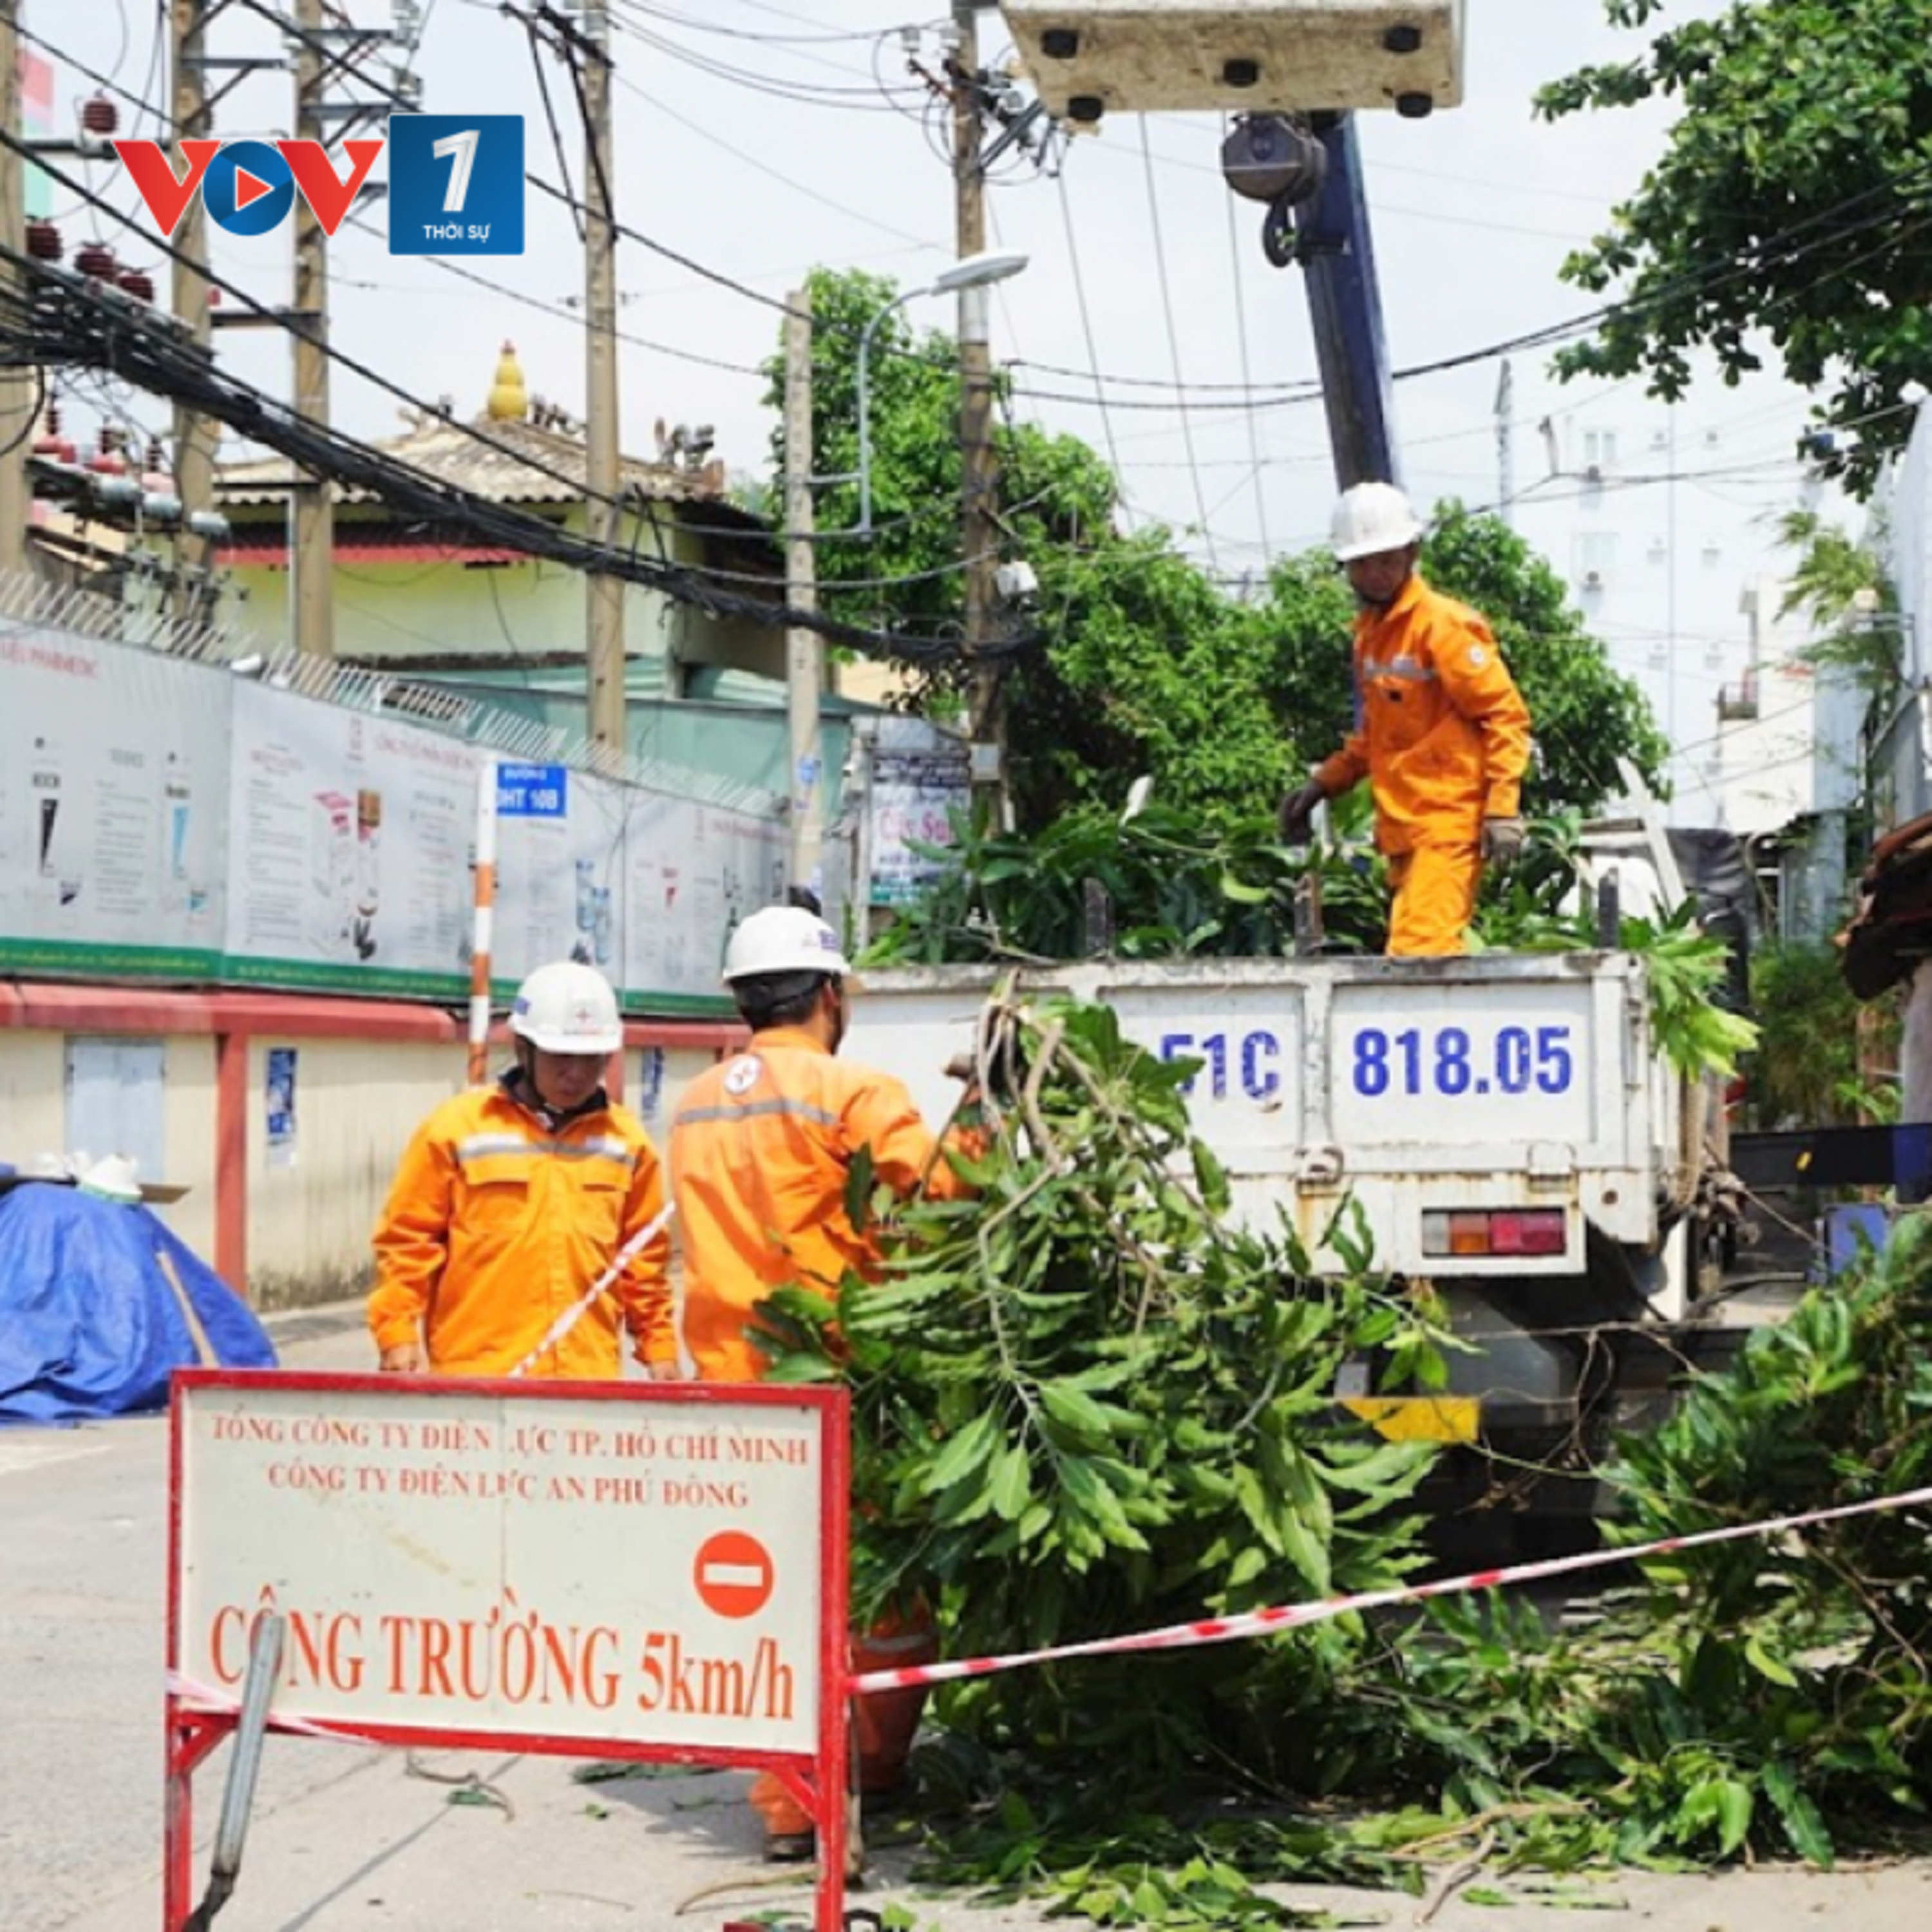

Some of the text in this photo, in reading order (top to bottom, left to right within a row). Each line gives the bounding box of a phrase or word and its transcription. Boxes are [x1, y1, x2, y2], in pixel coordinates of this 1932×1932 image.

[1352, 1026, 1573, 1097] 818.05
[211, 1403, 809, 1466] TỔNG CÔNG TY ĐIỆN ỰC TP. HỒ CHÍ MINH
[267, 1455, 345, 1492] CÔNG
[354, 1466, 388, 1492] TY
[399, 1461, 470, 1499] ĐIỆN
[547, 1475, 585, 1501] AN
[594, 1468, 652, 1506] PHÚ
[663, 1472, 750, 1509] ĐÔNG
[379, 1586, 621, 1710] TRƯỜNG
[637, 1632, 793, 1720] 5km/h
